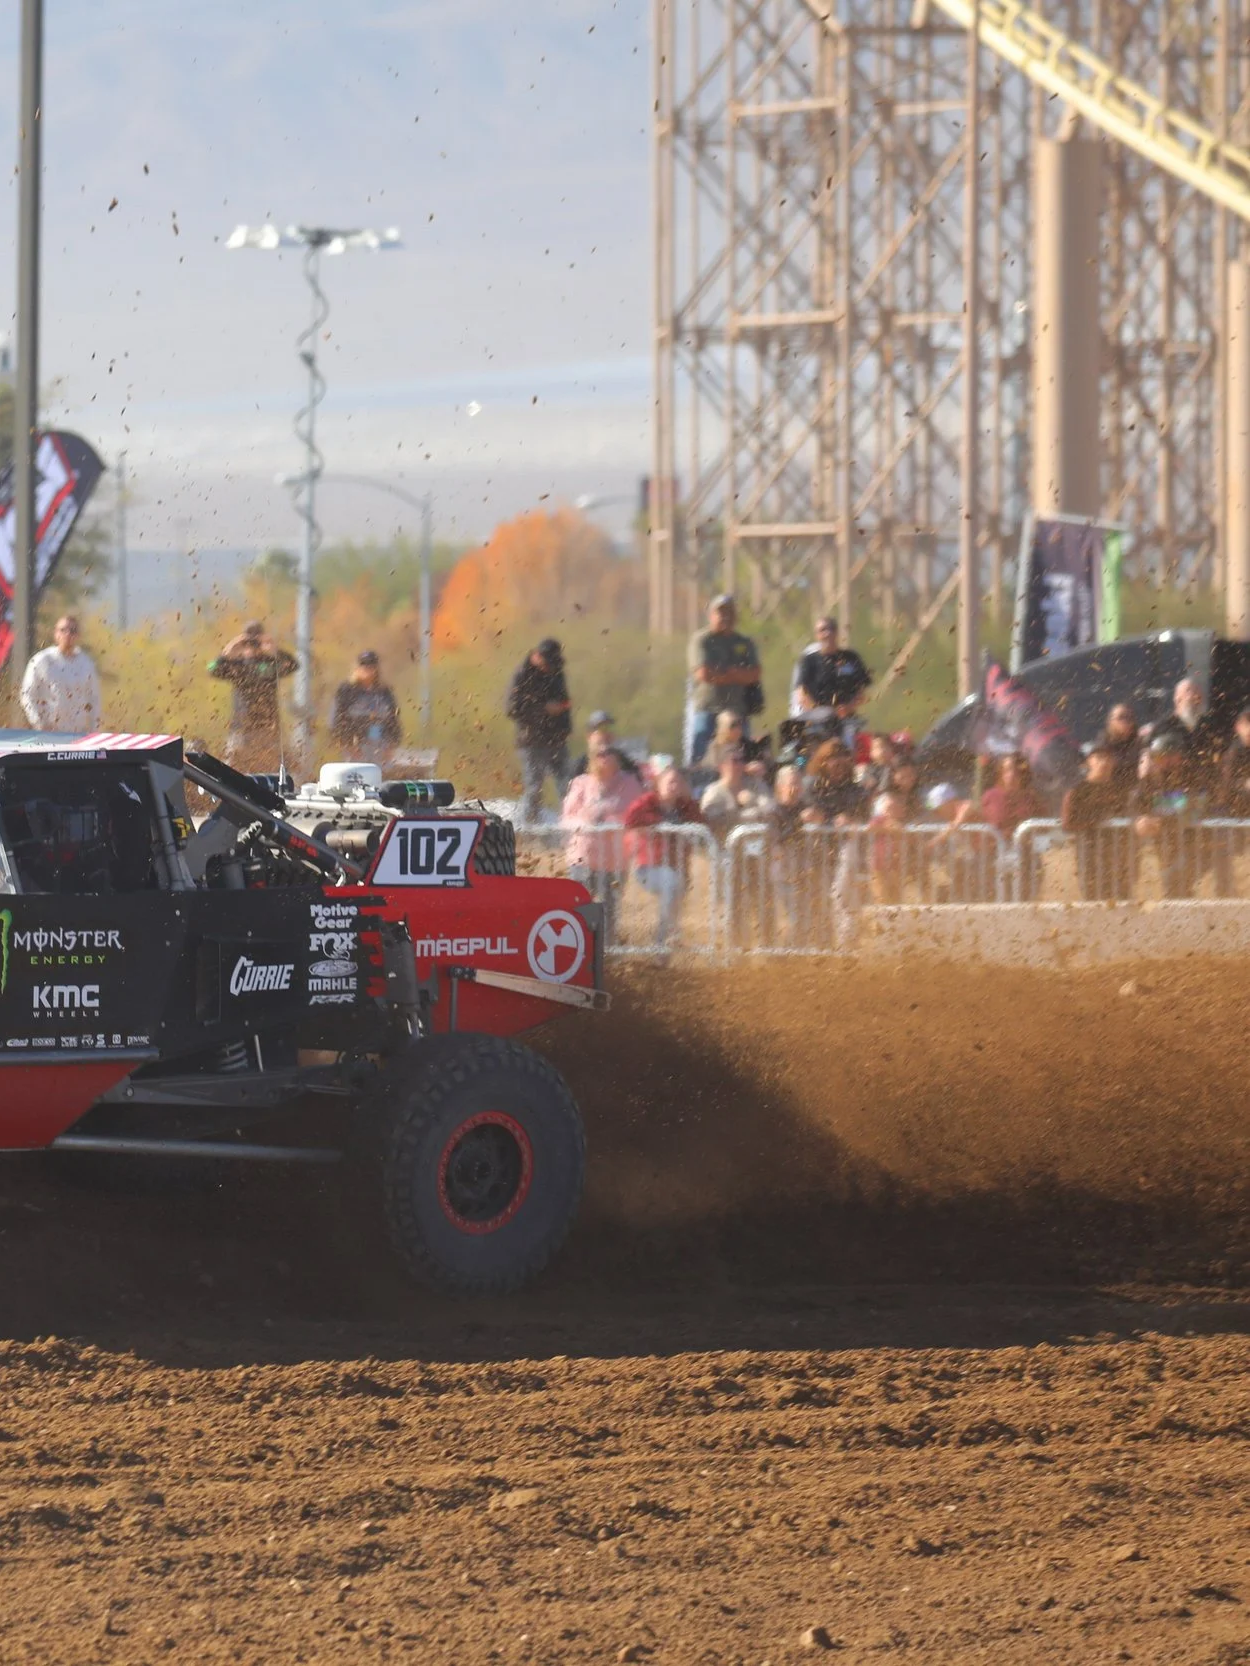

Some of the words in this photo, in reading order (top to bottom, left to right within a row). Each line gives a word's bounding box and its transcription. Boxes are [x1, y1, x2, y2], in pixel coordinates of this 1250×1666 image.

[47, 750, 96, 761] C.CURRIE
[396, 827, 462, 875] 102
[310, 904, 358, 917] Motive
[314, 917, 352, 929] Gear
[13, 926, 123, 952] MONSTER
[309, 932, 358, 959] FOX
[416, 937, 518, 957] MAGPUL
[30, 955, 106, 965] ENERGY
[230, 956, 294, 996] CURRIE
[309, 978, 357, 992] MAHLE
[33, 985, 100, 1008] KMC
[33, 1010, 100, 1018] WHEELS
